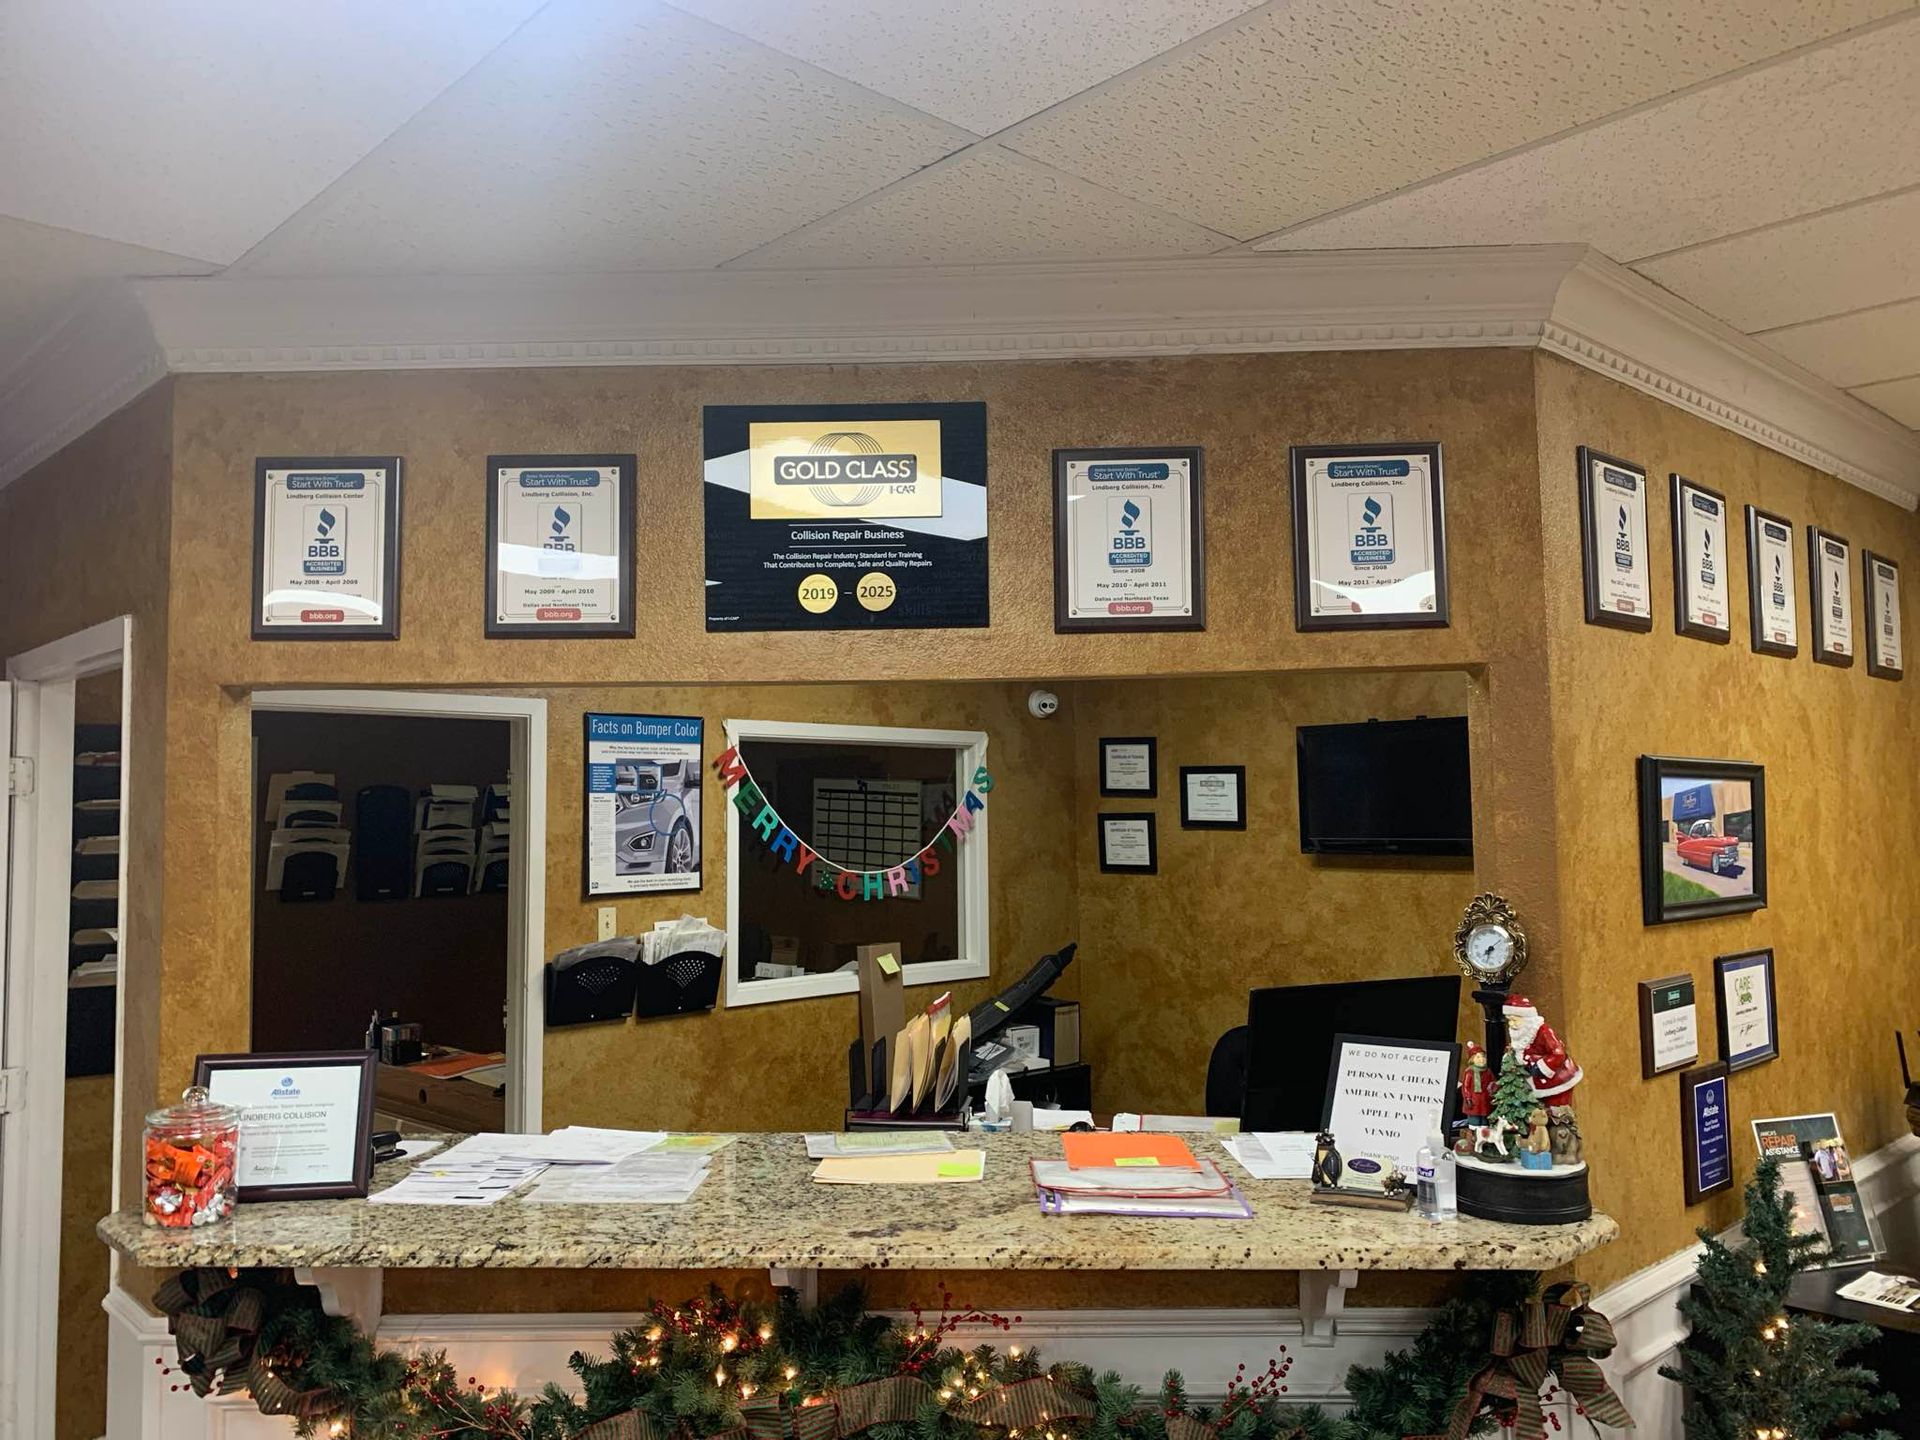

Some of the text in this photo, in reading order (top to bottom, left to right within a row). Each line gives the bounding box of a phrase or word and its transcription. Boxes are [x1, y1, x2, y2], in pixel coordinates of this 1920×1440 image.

[780, 460, 911, 479] GOLD CLASS
[1115, 471, 1136, 479] With
[292, 480, 311, 488] Start
[313, 480, 332, 488] With
[547, 478, 567, 486] With
[890, 485, 916, 494] I-CAR
[791, 530, 904, 541] Collision Repair Business
[1355, 534, 1388, 547] BBB
[1113, 537, 1146, 550] BBB
[308, 545, 339, 558] BBB
[834, 552, 858, 560] Industry
[825, 561, 856, 569] Complete,
[886, 560, 908, 568] Quality
[803, 588, 834, 599] 2019
[860, 586, 893, 597] 2025
[593, 719, 698, 738] Facts on Bumper Color
[712, 746, 816, 875] MERRY
[837, 766, 994, 901] CHRISTMAS
[1382, 1052, 1399, 1060] NOT
[1403, 1055, 1439, 1064] ACCEPT
[1347, 1070, 1440, 1085] PERSONAL CHECKS
[1344, 1088, 1444, 1104] AMERICAN EXPRESS
[240, 1111, 327, 1121] LINDBERG COLLISION
[1360, 1108, 1416, 1121] APPLE PAY
[1364, 1128, 1400, 1138] VENMO
[1761, 1134, 1797, 1149] REPAIR
